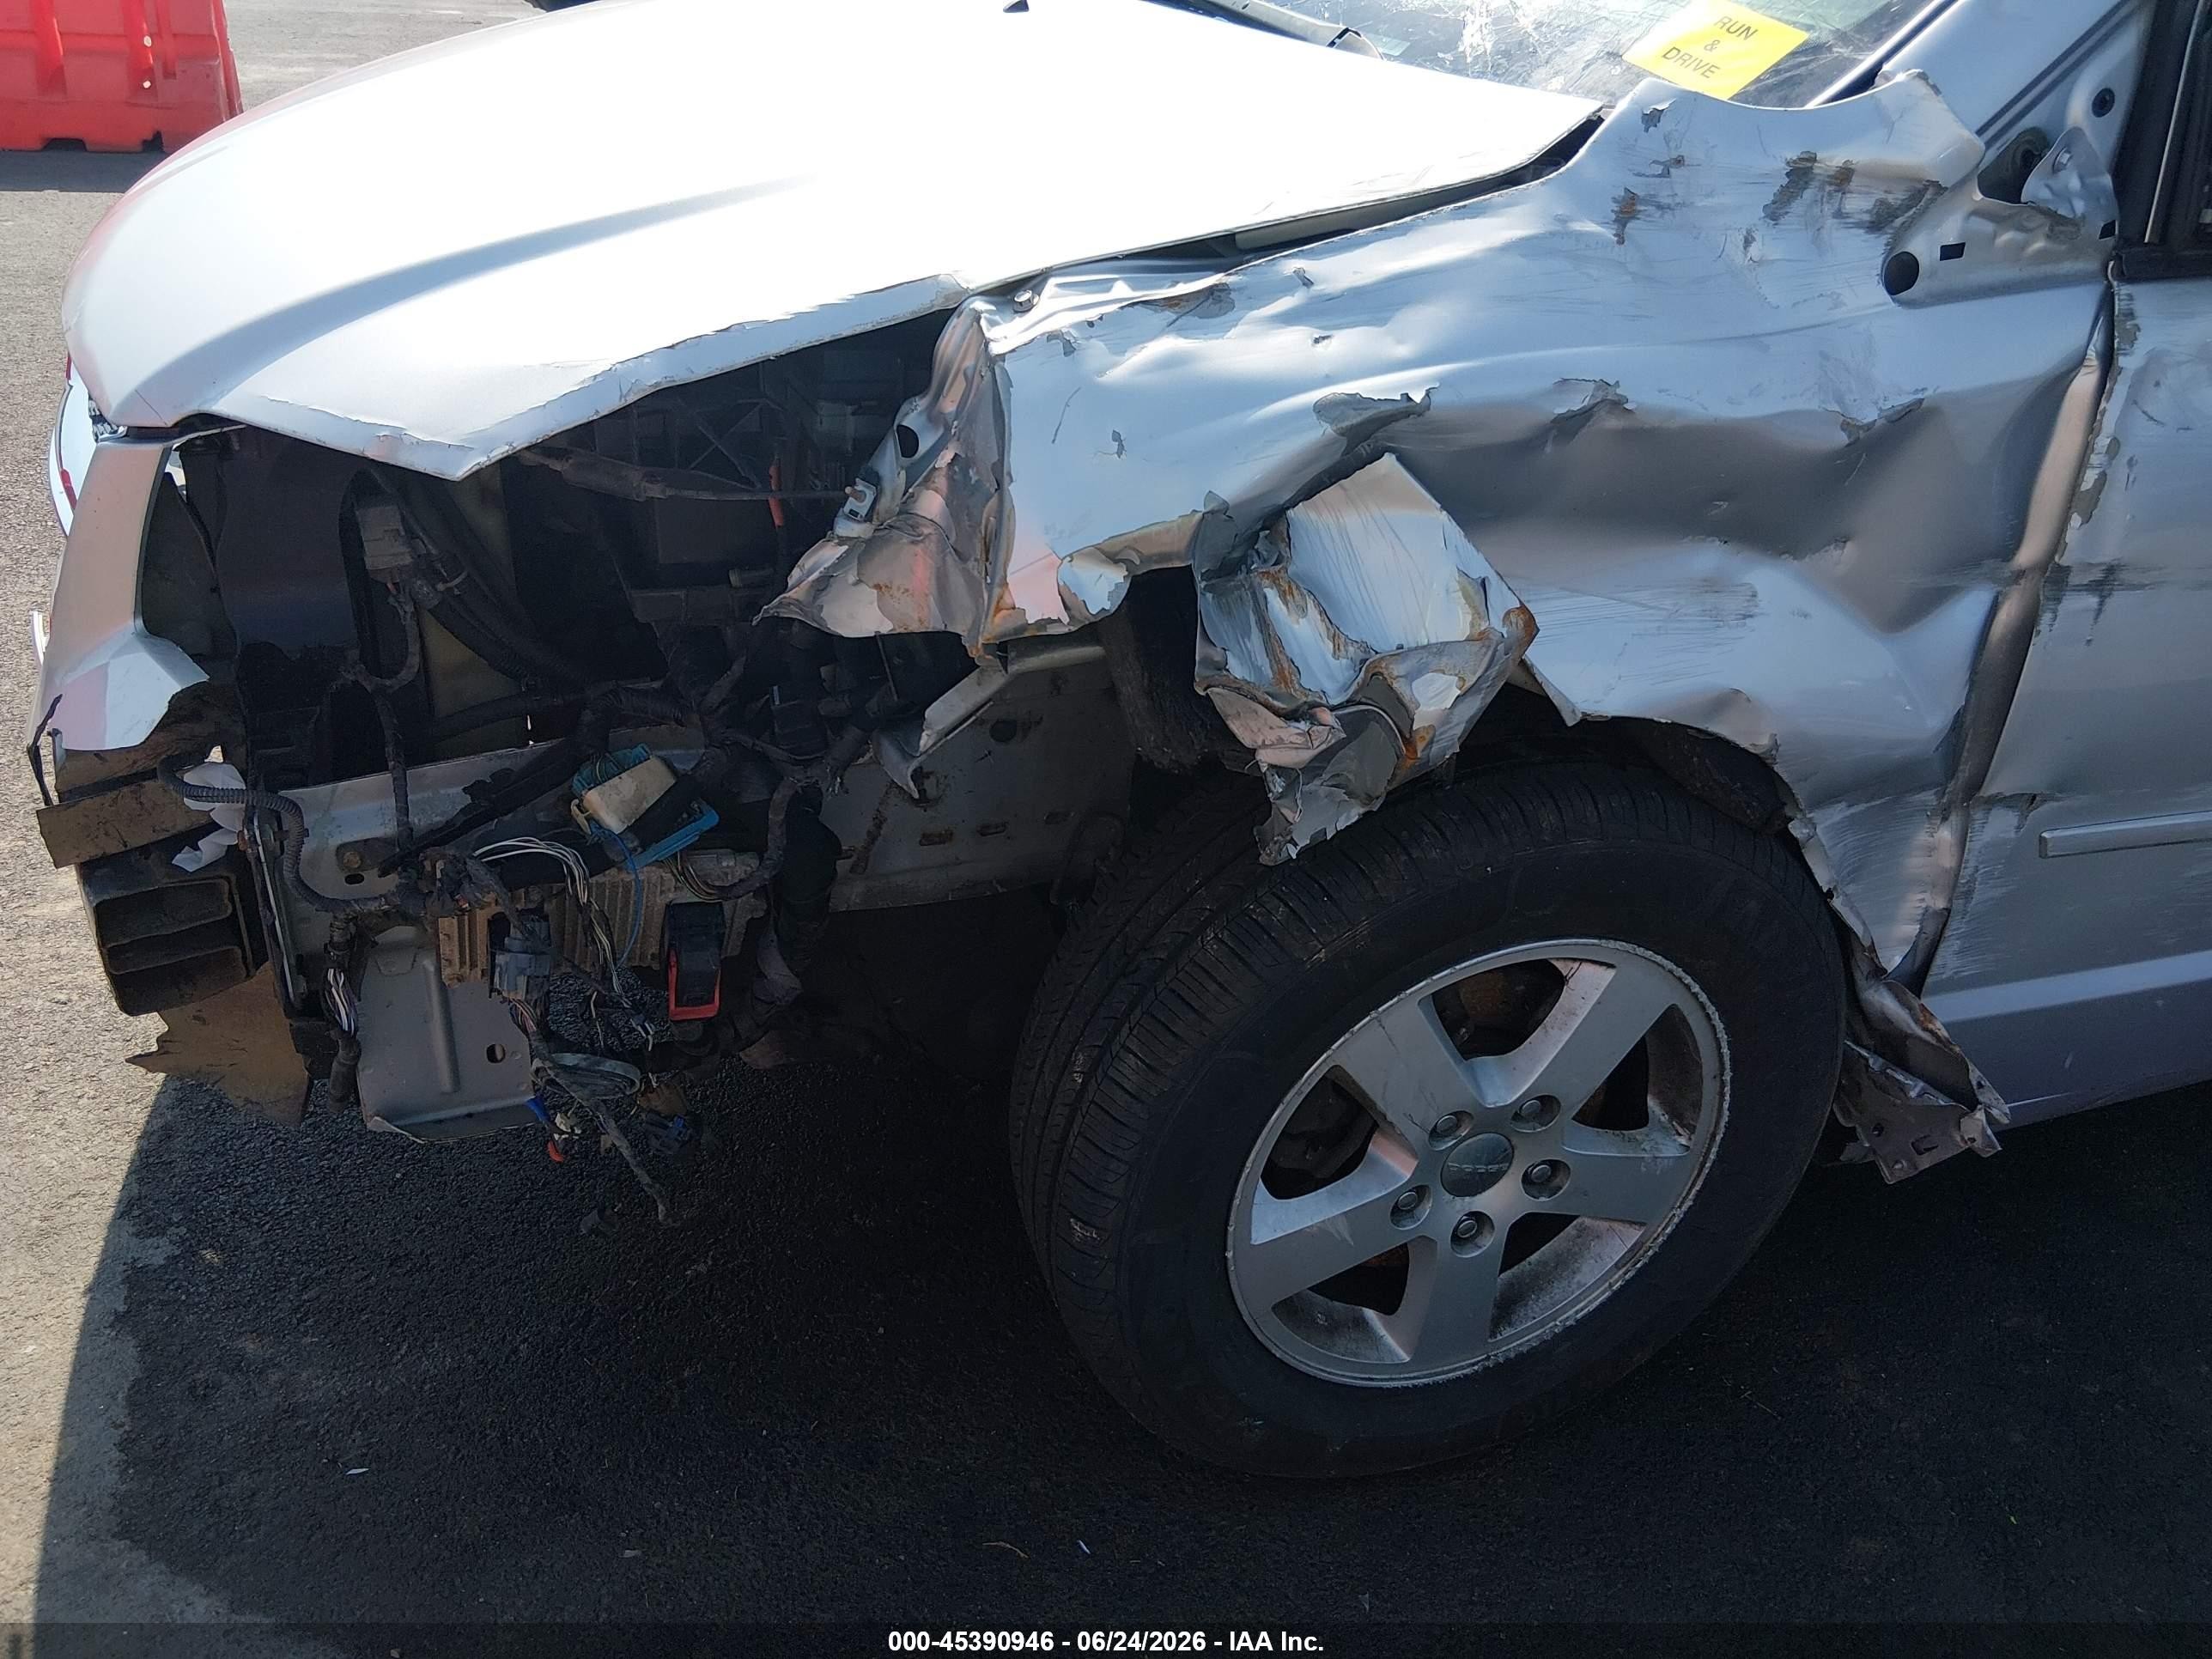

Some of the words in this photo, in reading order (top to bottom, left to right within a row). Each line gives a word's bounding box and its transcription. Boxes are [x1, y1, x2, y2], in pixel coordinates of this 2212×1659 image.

[1713, 15, 1759, 41] RUN
[1704, 40, 1721, 52] &
[1662, 46, 1721, 79] DRIVE
